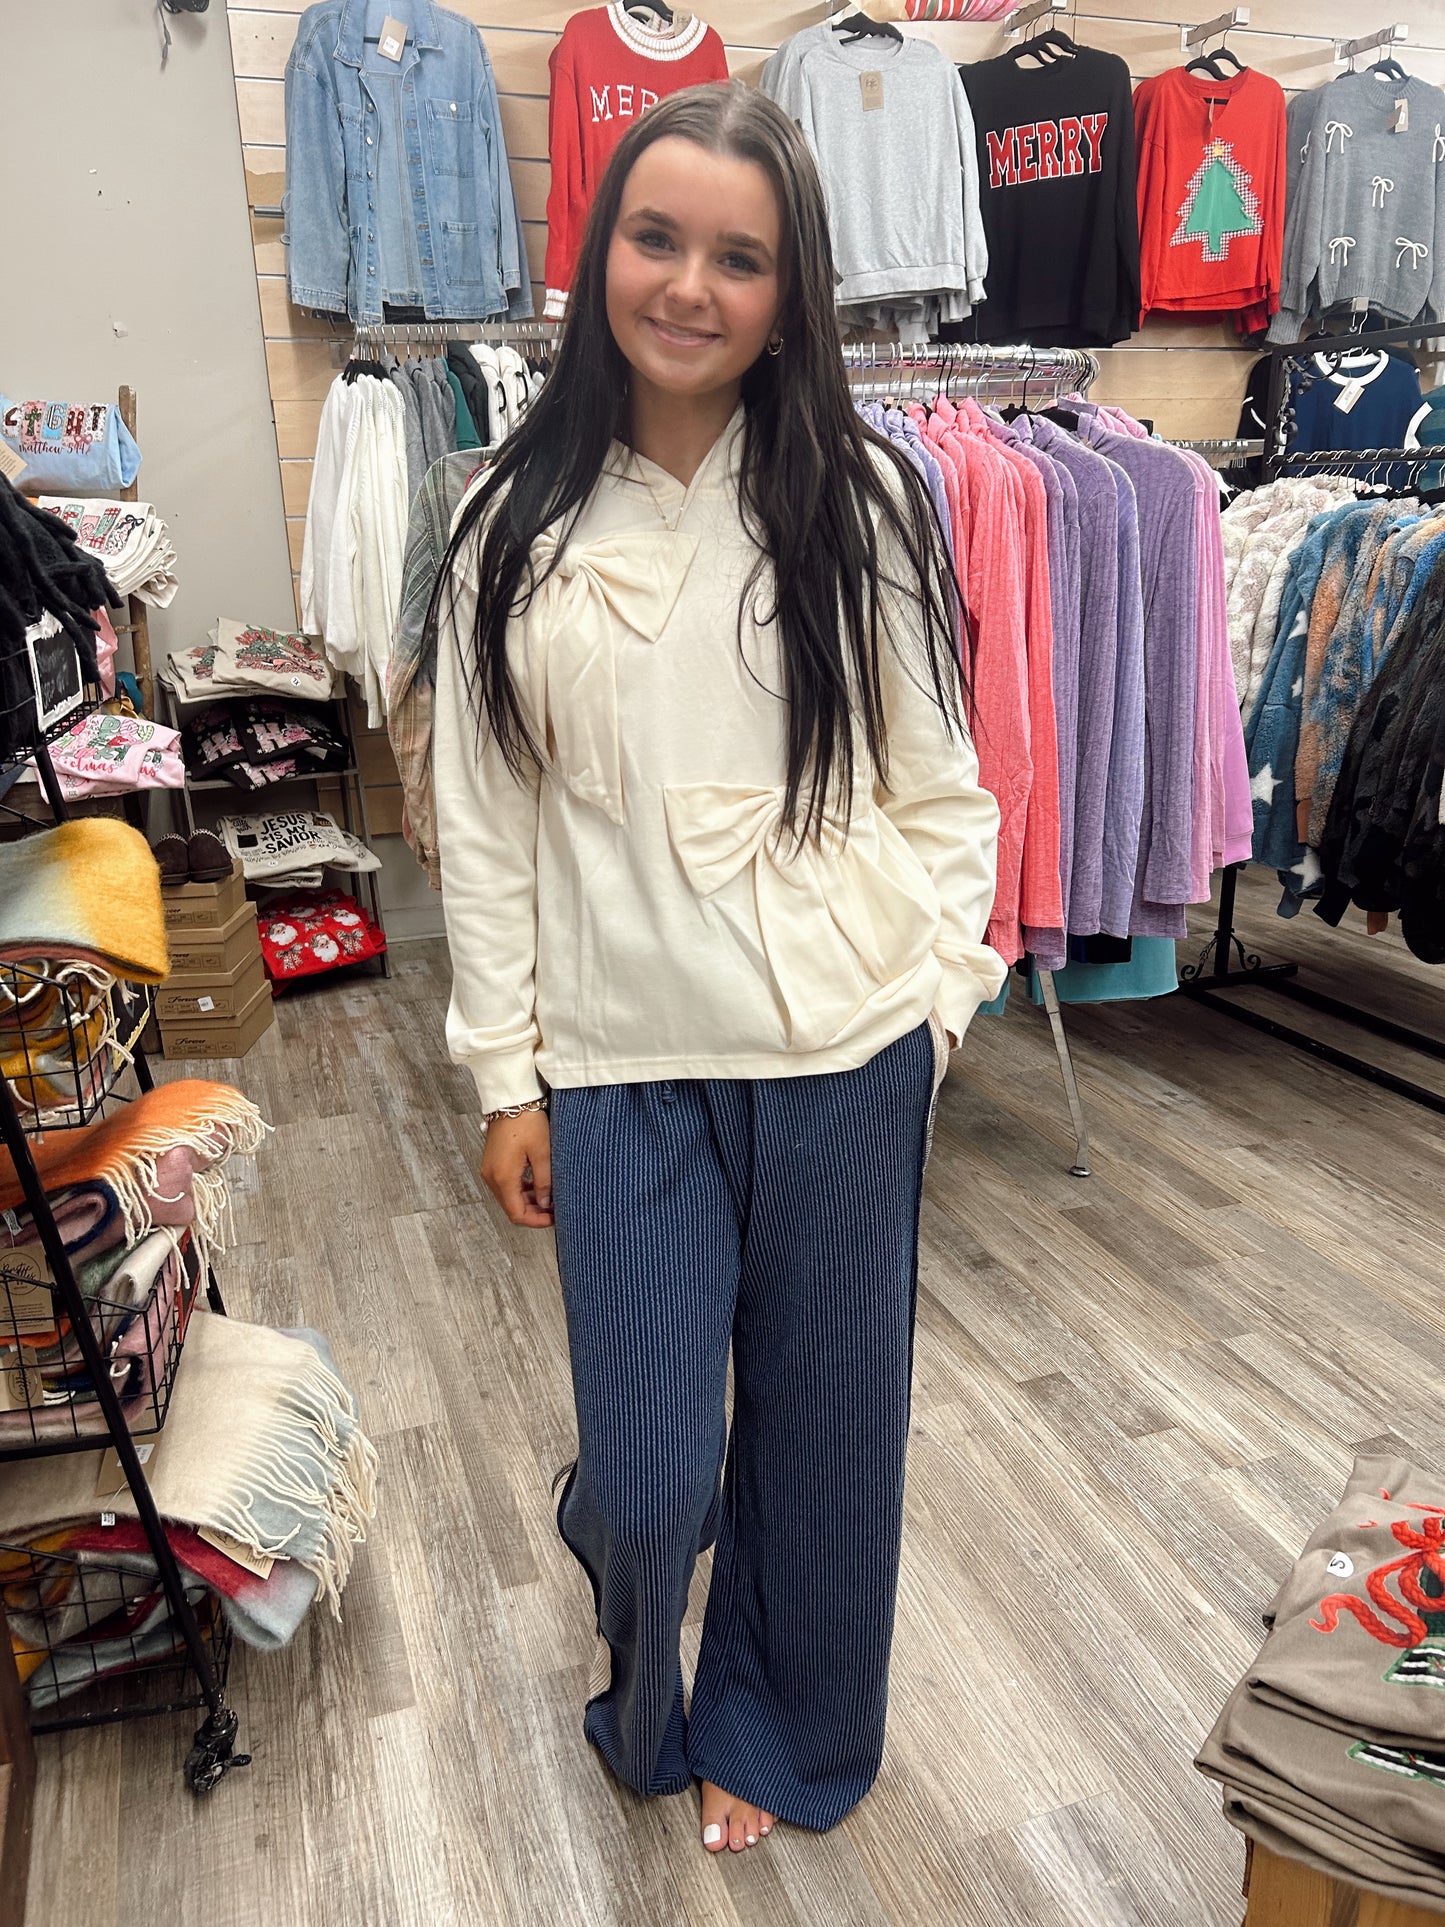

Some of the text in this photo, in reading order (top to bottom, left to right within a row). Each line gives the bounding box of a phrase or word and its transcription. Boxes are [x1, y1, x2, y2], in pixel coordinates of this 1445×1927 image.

[986, 112, 1108, 189] MERRY
[260, 813, 308, 835] JESUS
[269, 824, 307, 842] IS MY
[265, 830, 321, 854] SAVIOR
